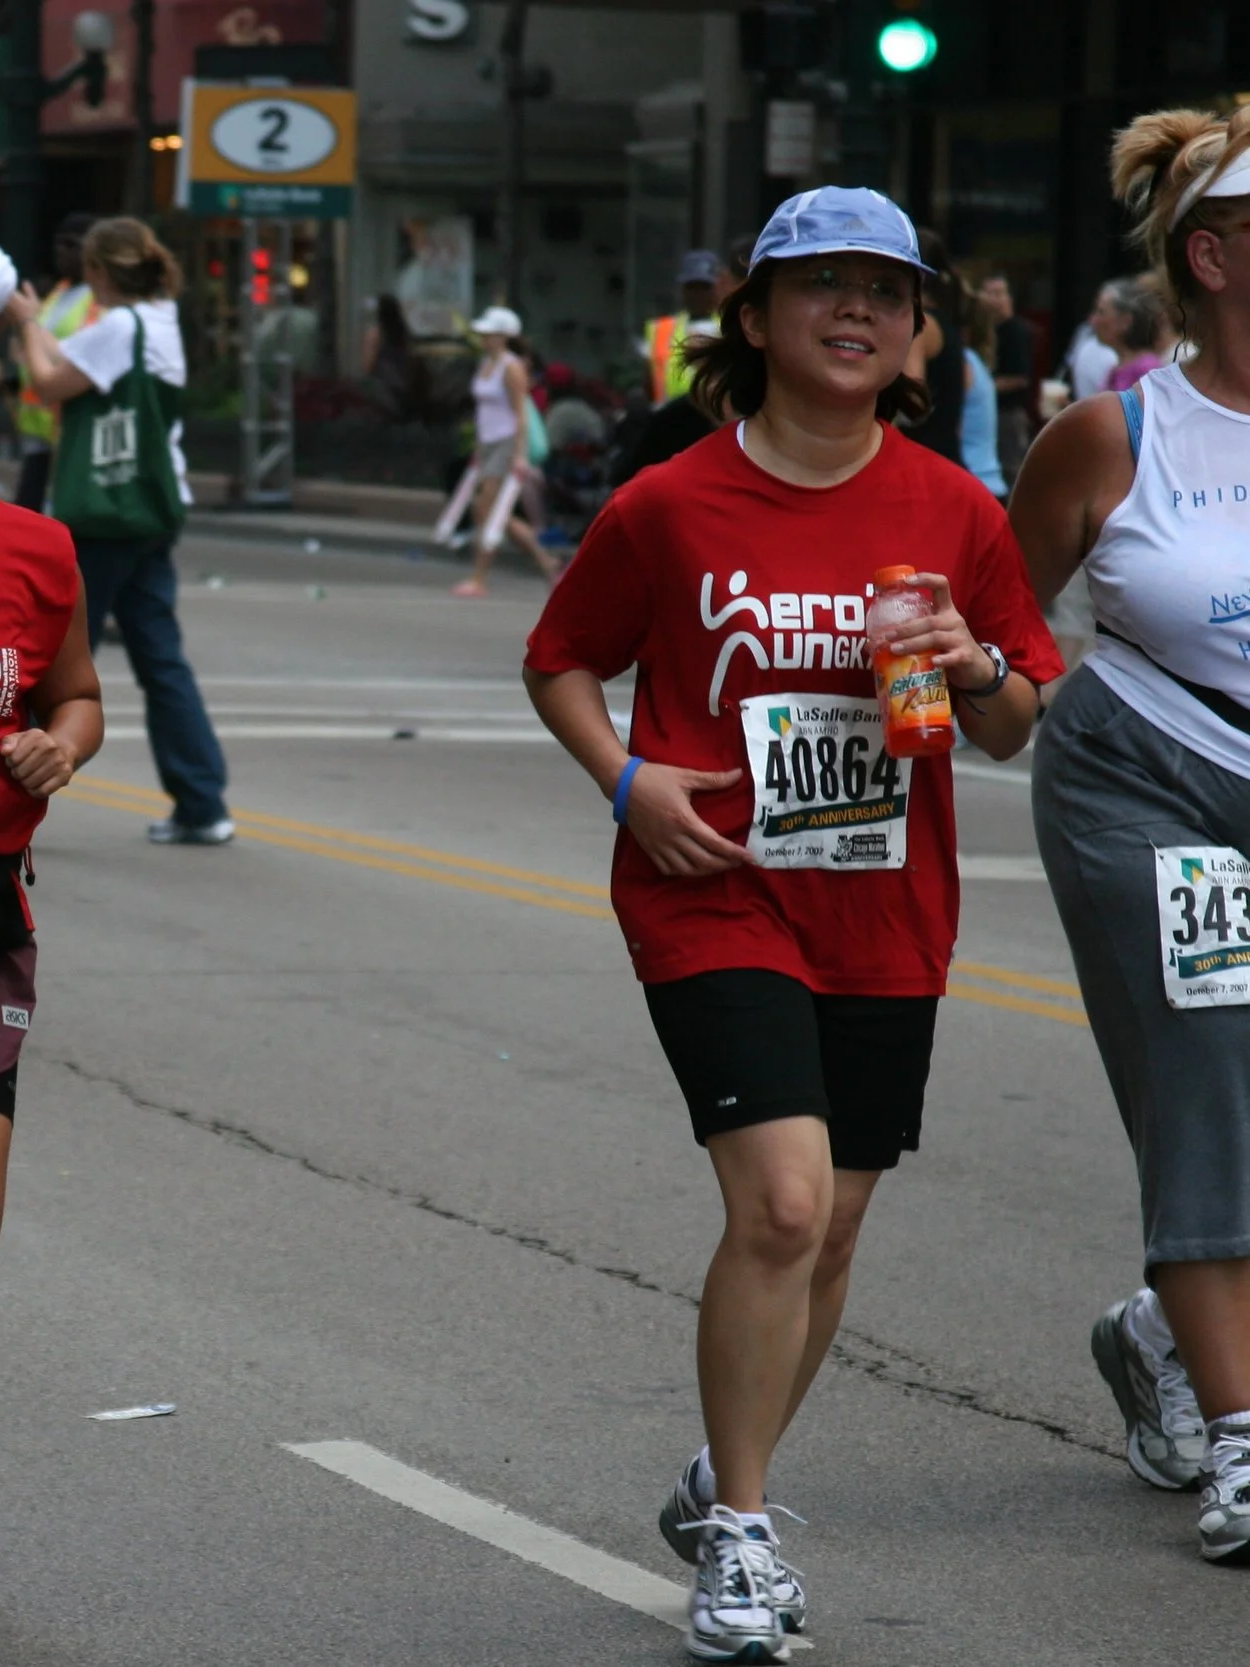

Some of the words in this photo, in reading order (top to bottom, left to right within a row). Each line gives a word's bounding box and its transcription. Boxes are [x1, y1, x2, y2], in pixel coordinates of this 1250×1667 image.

[258, 107, 290, 153] 2
[1, 648, 16, 717] MARATHON
[796, 706, 849, 722] LaSalle
[852, 709, 881, 723] Ban
[765, 736, 900, 803] 40864
[778, 816, 805, 832] 30th
[807, 802, 896, 827] ANNIVERSARY
[764, 846, 795, 857] October
[1211, 859, 1250, 875] LaSall
[1194, 956, 1221, 972] 30th
[1186, 987, 1218, 997] October
[1230, 983, 1248, 993] 2007
